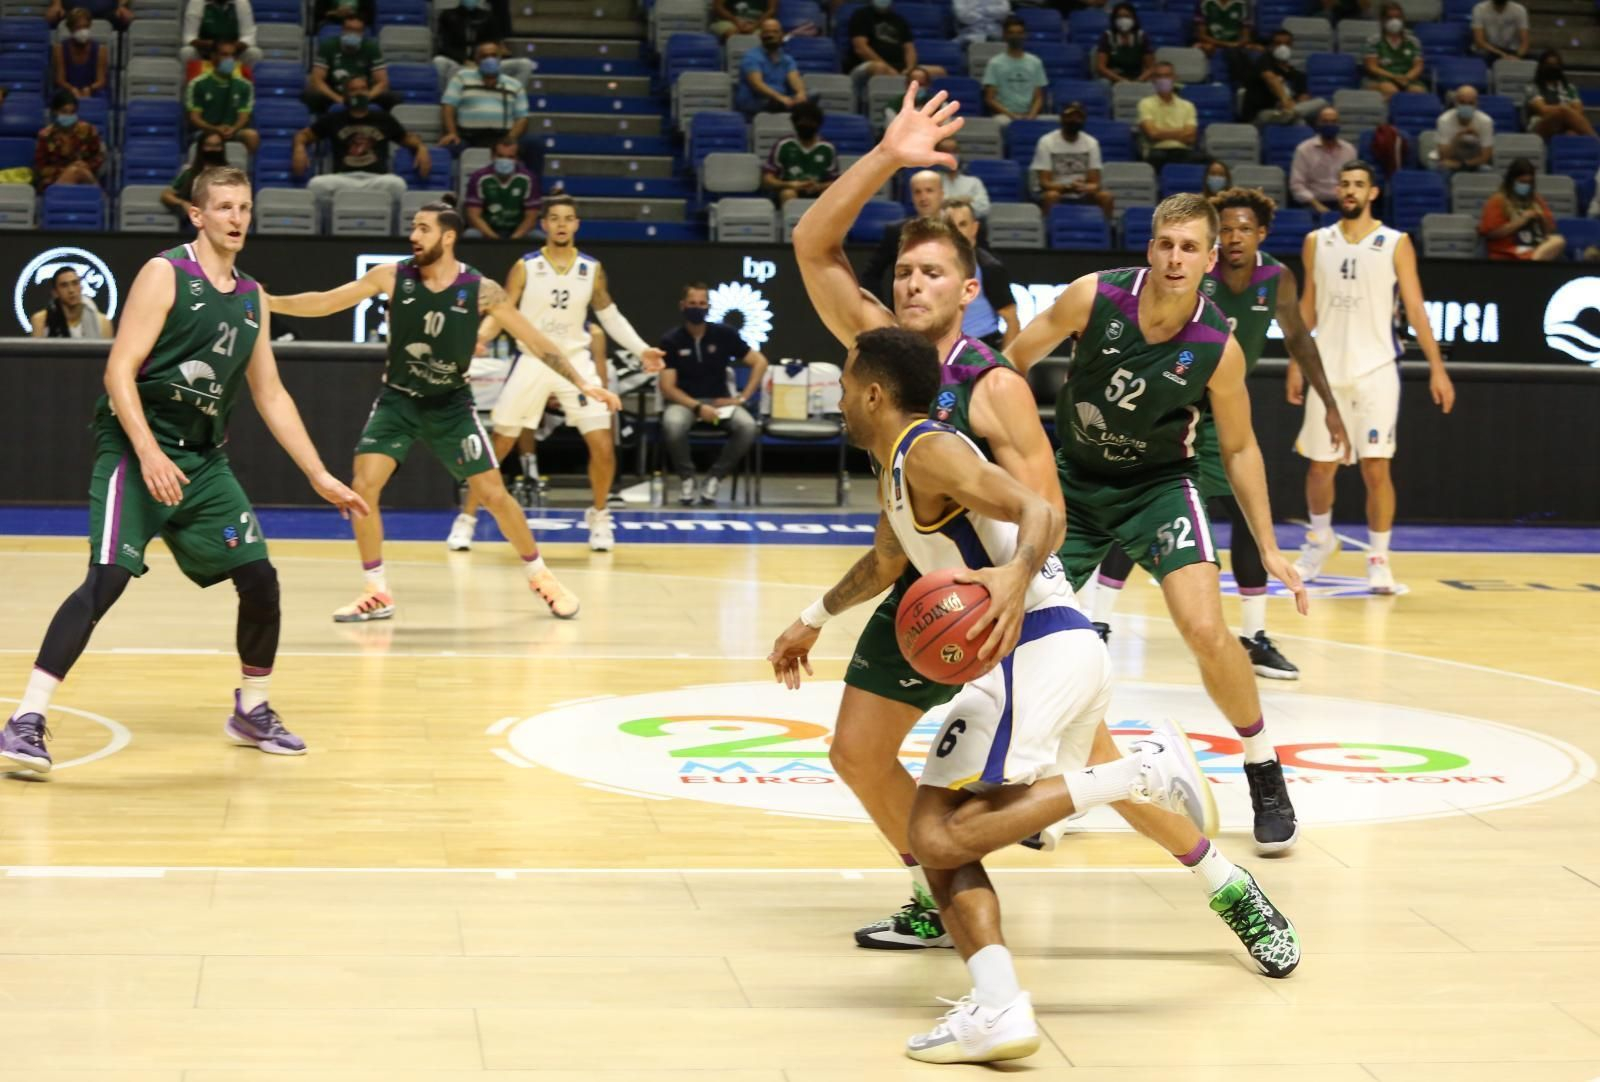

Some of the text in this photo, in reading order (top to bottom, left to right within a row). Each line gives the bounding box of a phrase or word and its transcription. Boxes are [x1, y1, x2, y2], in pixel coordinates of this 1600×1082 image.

[743, 256, 776, 283] bp
[1340, 258, 1357, 280] 41
[550, 289, 570, 310] 32
[424, 310, 446, 338] 10
[212, 321, 238, 357] 21
[1105, 367, 1147, 411] 52
[1157, 516, 1196, 555] 52
[936, 718, 967, 758] 6
[1344, 776, 1507, 785] SPORT
